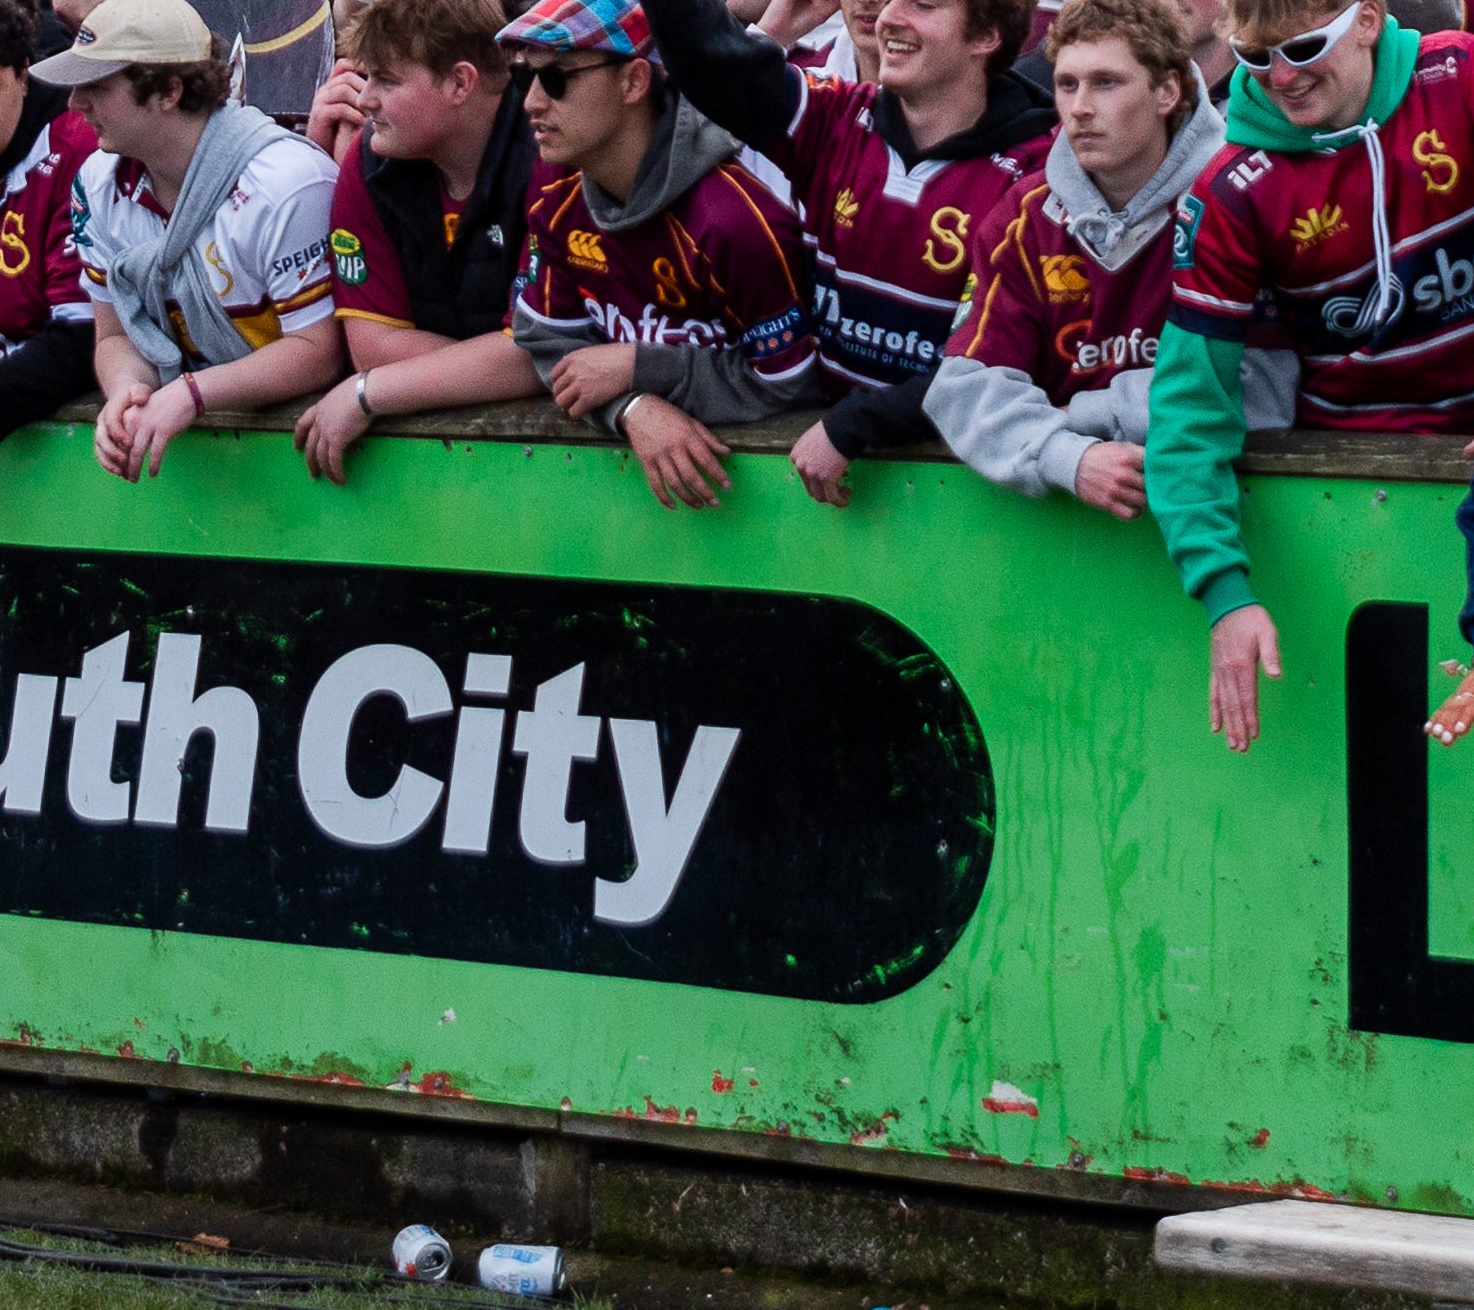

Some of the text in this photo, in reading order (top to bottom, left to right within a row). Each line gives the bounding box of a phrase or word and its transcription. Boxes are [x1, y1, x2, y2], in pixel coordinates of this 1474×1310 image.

[272, 233, 330, 278] SPEIGH
[840, 316, 936, 361] zerofe
[296, 642, 742, 927] City
